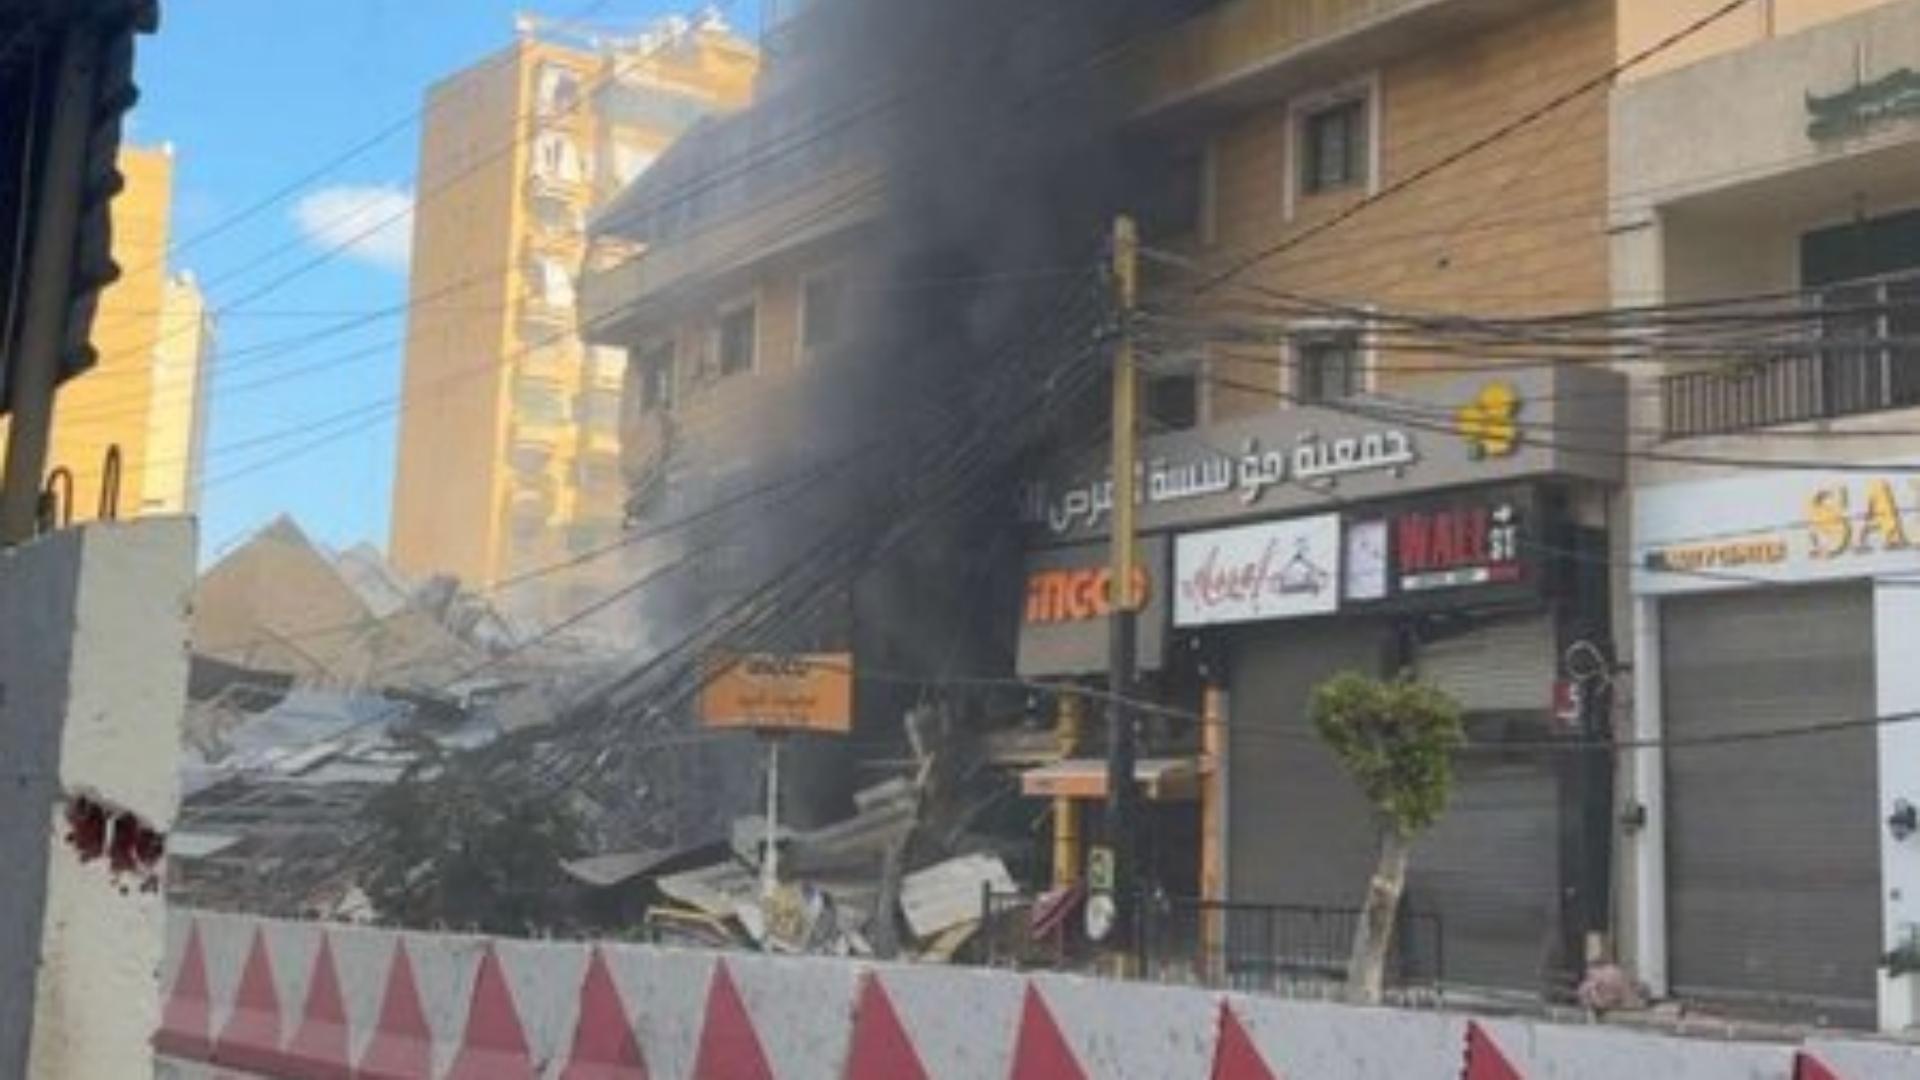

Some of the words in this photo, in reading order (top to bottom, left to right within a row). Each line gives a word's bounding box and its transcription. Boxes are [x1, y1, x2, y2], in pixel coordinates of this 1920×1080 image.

[1294, 430, 1414, 486] جمعية
[1398, 508, 1488, 572] WALL
[1806, 477, 1920, 559] SA
